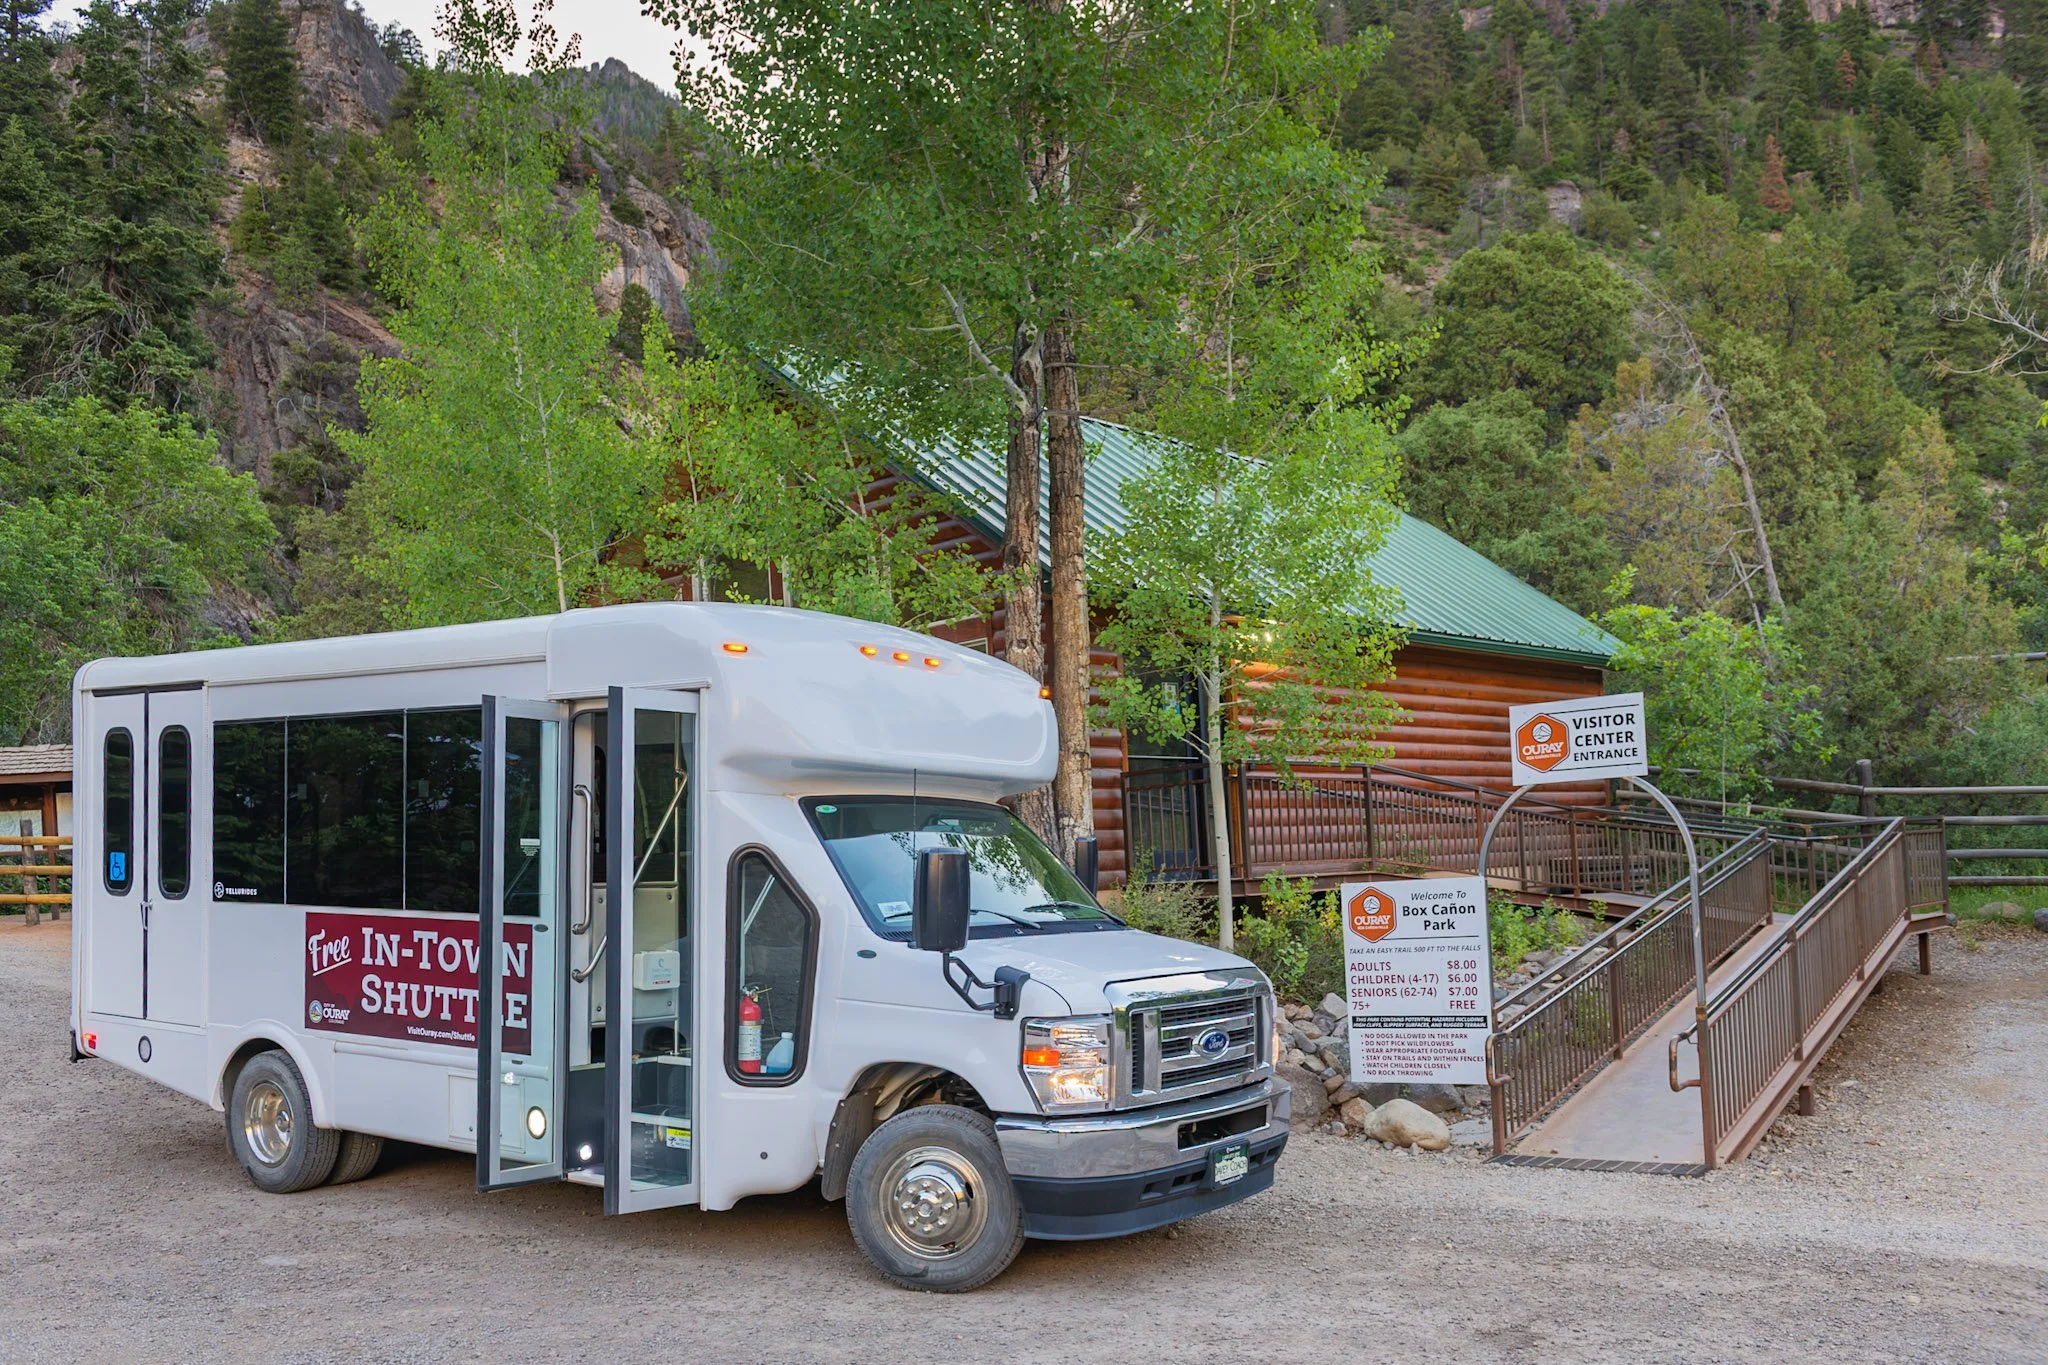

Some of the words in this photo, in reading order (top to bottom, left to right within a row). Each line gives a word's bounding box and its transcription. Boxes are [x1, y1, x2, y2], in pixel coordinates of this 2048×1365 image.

[1573, 713, 1635, 729] VISITOR
[1575, 731, 1634, 746] CENTER
[1522, 742, 1564, 755] OURAY
[1574, 748, 1638, 761] ENTRANCE
[1411, 892, 1453, 900] Welcome
[1402, 906, 1427, 916] Box
[1432, 903, 1476, 915] Cañon
[1354, 915, 1391, 925] OURAY
[1424, 919, 1456, 930] Park
[308, 929, 350, 972] Free
[1350, 962, 1391, 971] ADULTS
[1447, 960, 1476, 970] $8.00
[1350, 974, 1405, 984] CHILDREN
[1408, 974, 1439, 984] (4-17)
[1448, 973, 1477, 983] $6.00
[1352, 988, 1397, 997] SENIORS
[1400, 987, 1437, 998] (62-74)
[1449, 987, 1477, 996] $7.00
[361, 974, 528, 1029] SHUTTE
[1352, 1002, 1370, 1010] 75+
[1450, 1000, 1476, 1009] FREE
[323, 1008, 350, 1020] OURAY
[407, 1026, 475, 1042] VisitOuray.com/Shuttle
[1209, 1036, 1224, 1049] Ford
[1230, 1160, 1247, 1171] COACH
